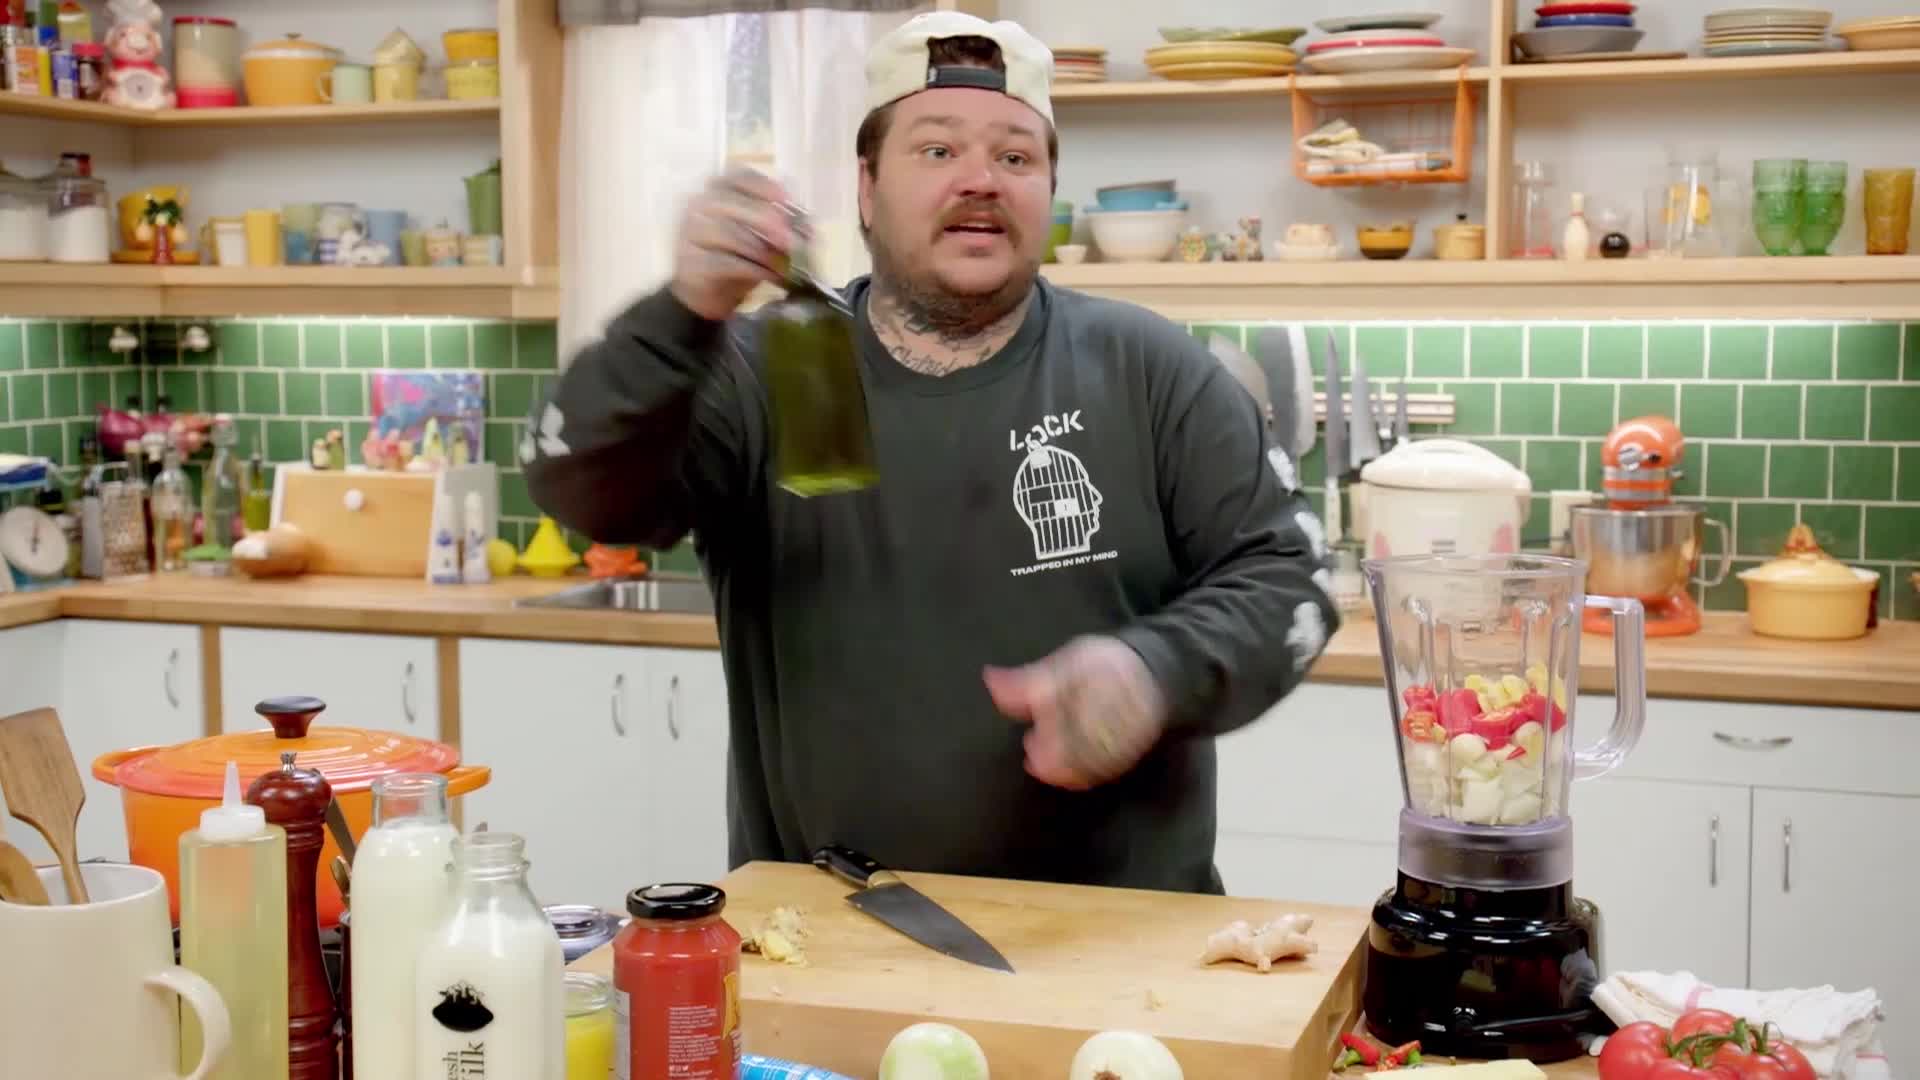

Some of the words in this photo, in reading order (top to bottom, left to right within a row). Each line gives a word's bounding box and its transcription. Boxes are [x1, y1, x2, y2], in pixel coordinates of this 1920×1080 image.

[1010, 409, 1085, 451] LOCK
[1010, 561, 1061, 577] TRAPPED
[1062, 558, 1074, 567] IN
[1075, 556, 1092, 566] MY
[1092, 550, 1118, 562] MIND
[442, 1051, 458, 1080] esh
[460, 1041, 484, 1080] ilk
